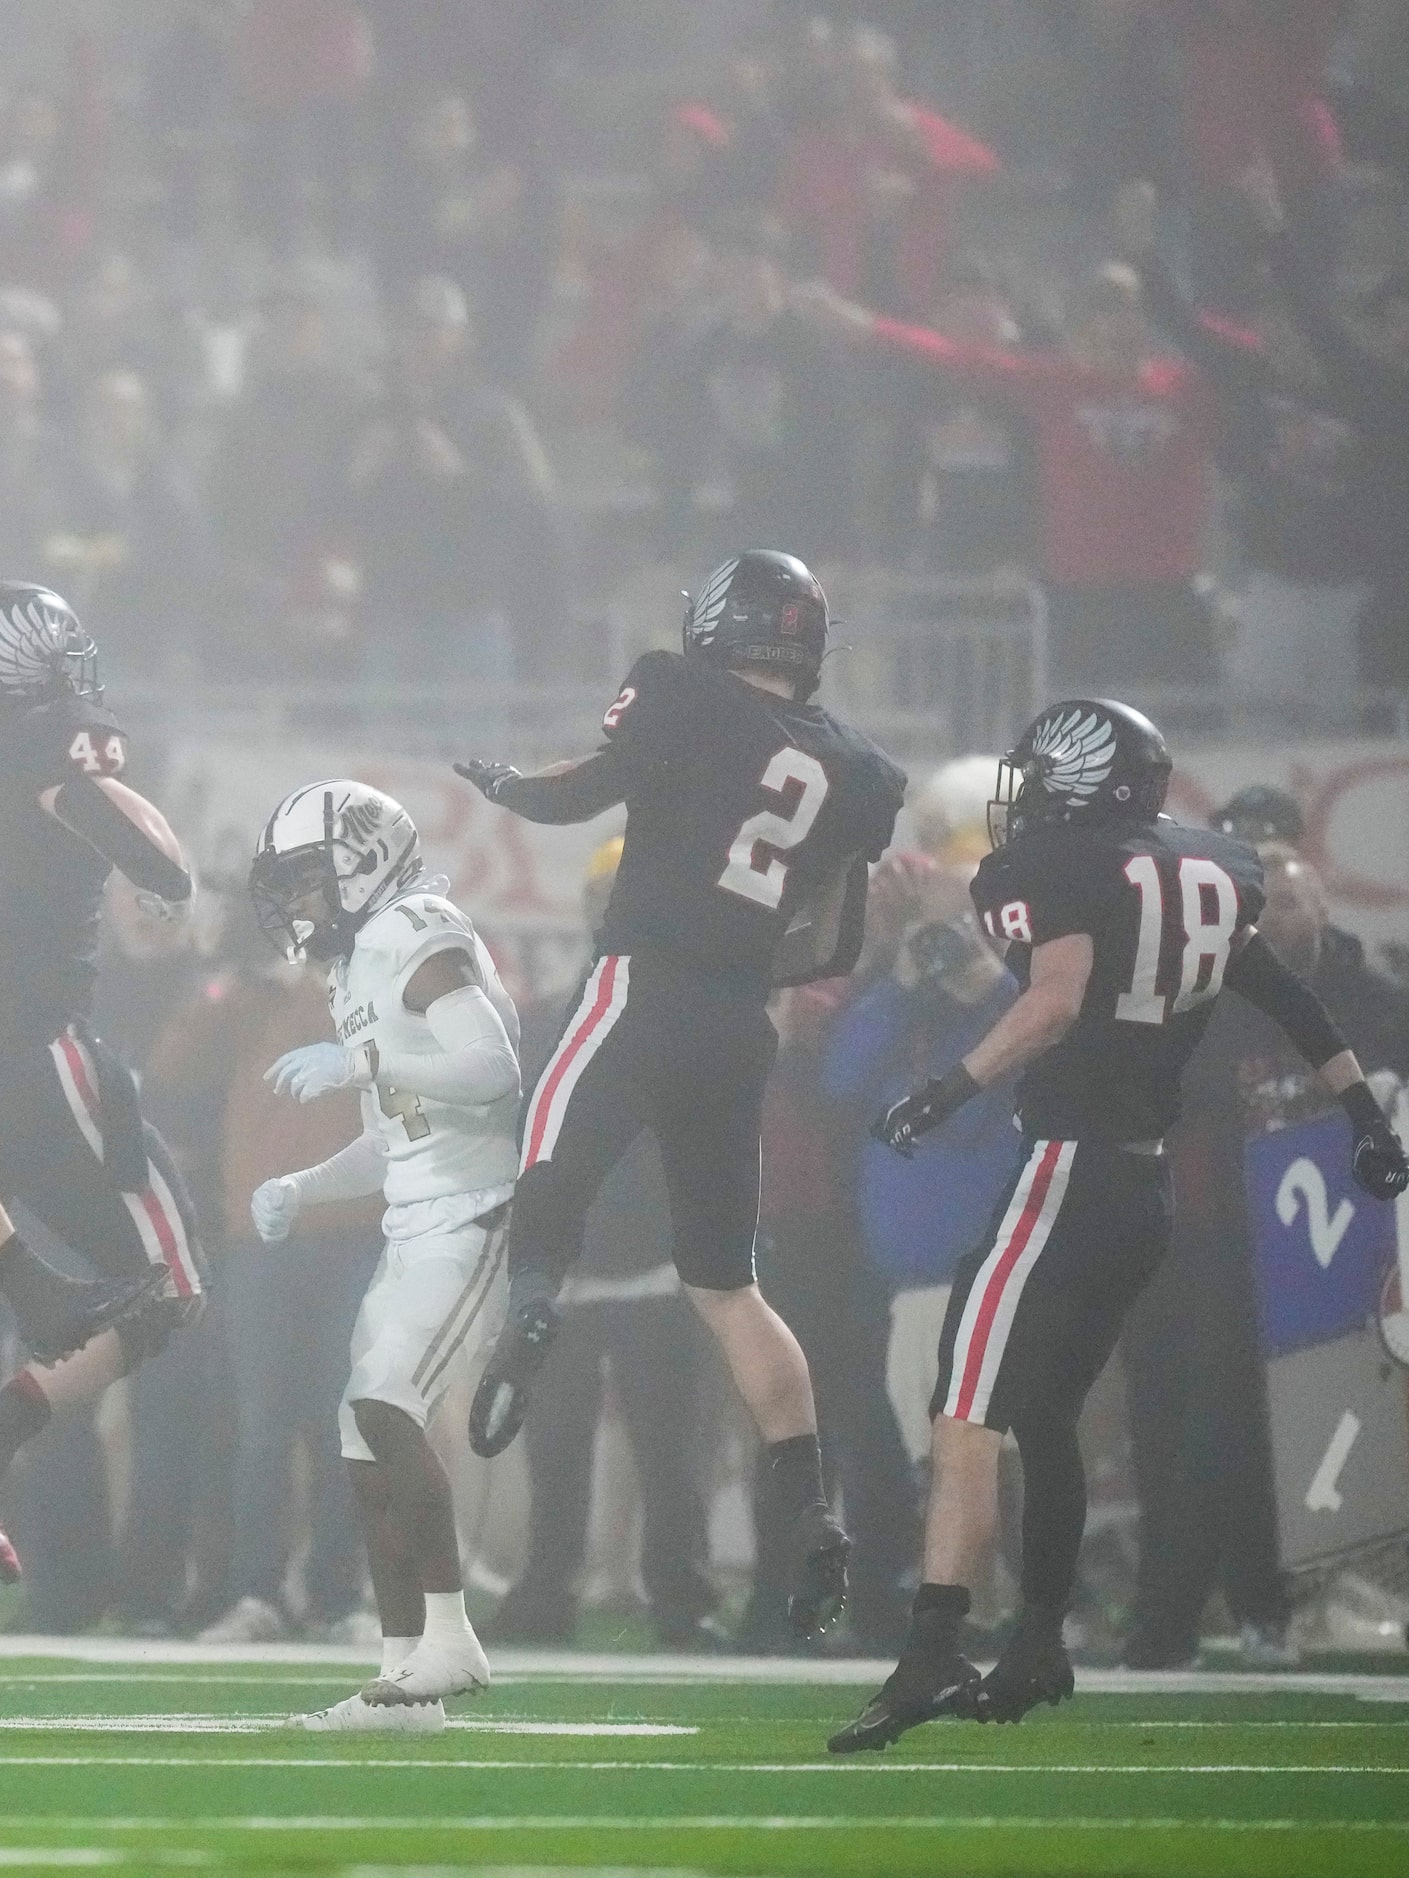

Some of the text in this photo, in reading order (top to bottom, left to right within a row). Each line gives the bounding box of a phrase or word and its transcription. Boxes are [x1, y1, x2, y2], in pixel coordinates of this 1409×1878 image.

[602, 686, 636, 729] 2
[69, 731, 126, 774] 44
[716, 746, 829, 909] 2
[983, 900, 1032, 943] 18
[1114, 855, 1241, 1024] 18
[1275, 1156, 1356, 1270] 2
